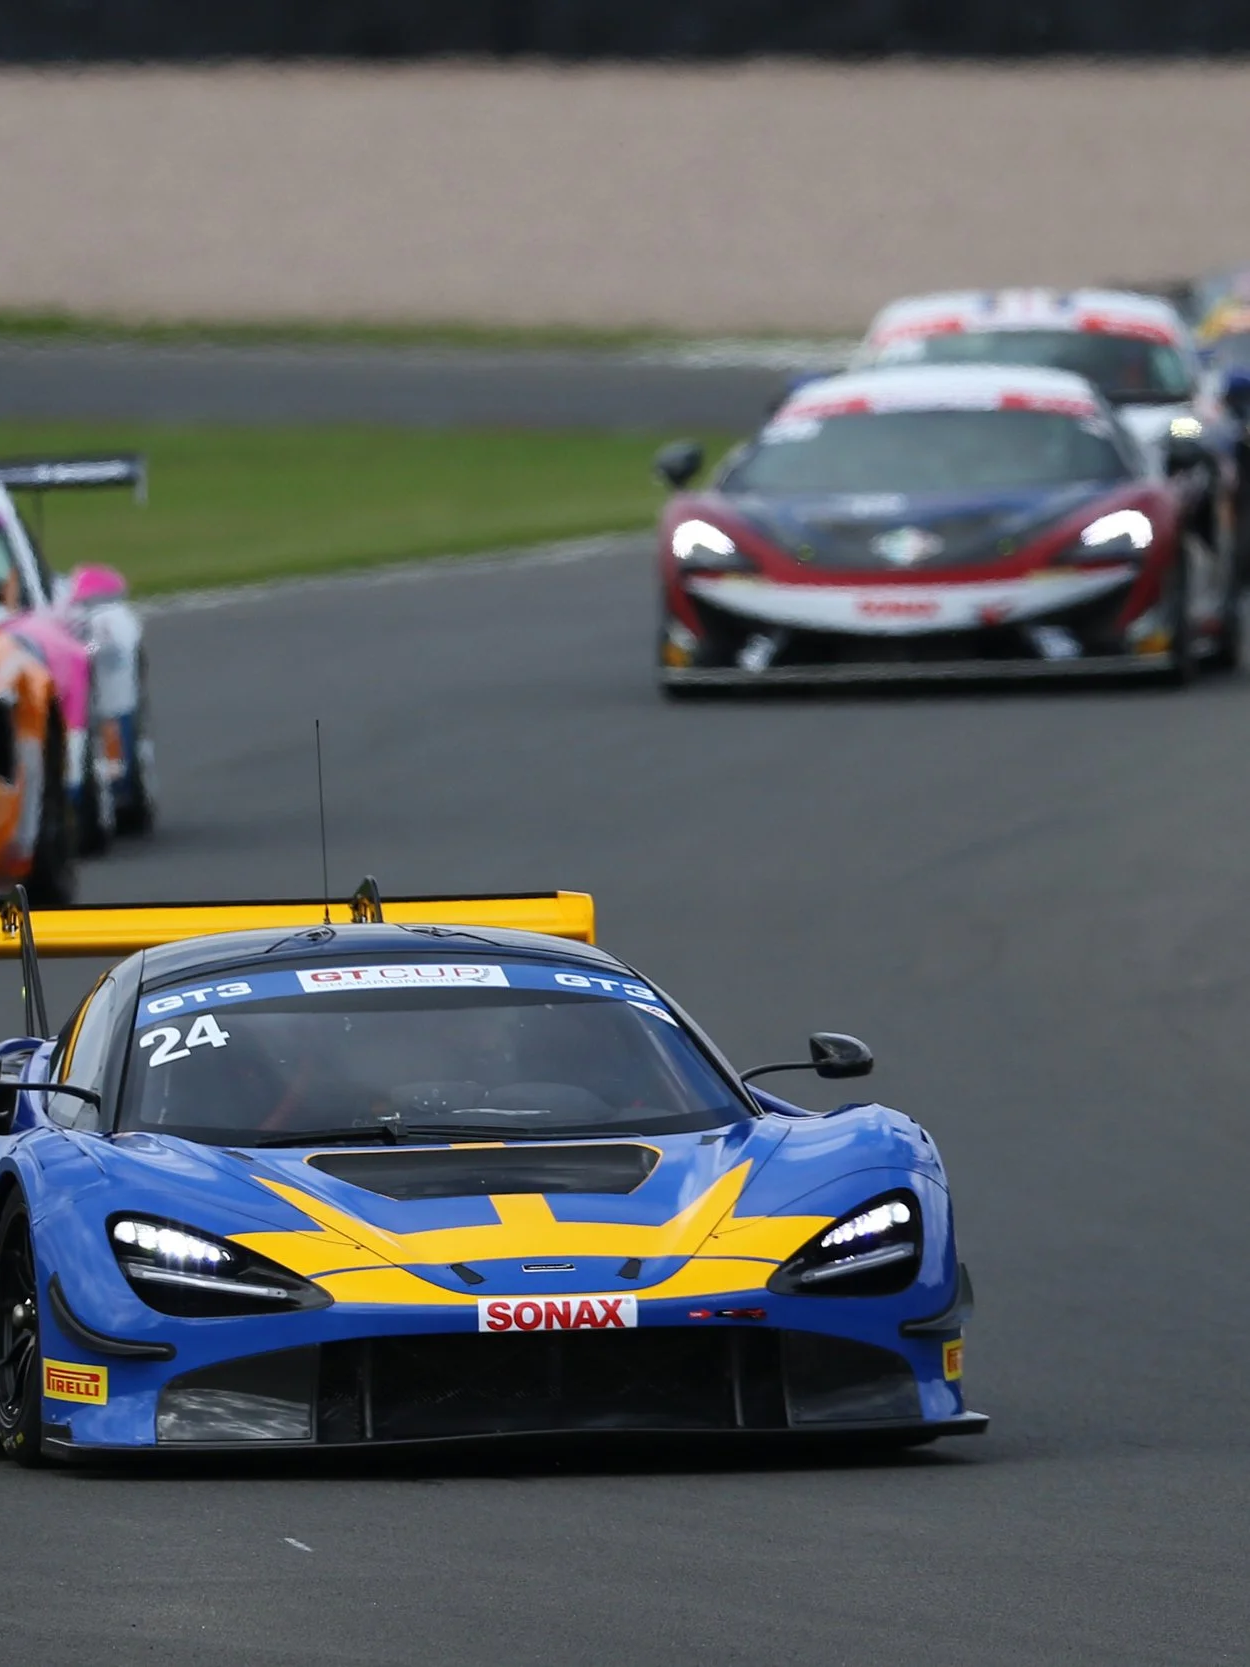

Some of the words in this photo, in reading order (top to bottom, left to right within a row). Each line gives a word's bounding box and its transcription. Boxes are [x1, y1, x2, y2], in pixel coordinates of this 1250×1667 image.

[310, 969, 368, 983] GT
[378, 966, 480, 980] CUP
[553, 973, 658, 1002] GT3
[146, 981, 253, 1014] GT3
[139, 1013, 231, 1068] 24
[486, 1298, 626, 1331] SONAX
[45, 1366, 101, 1397] PIRELLI
